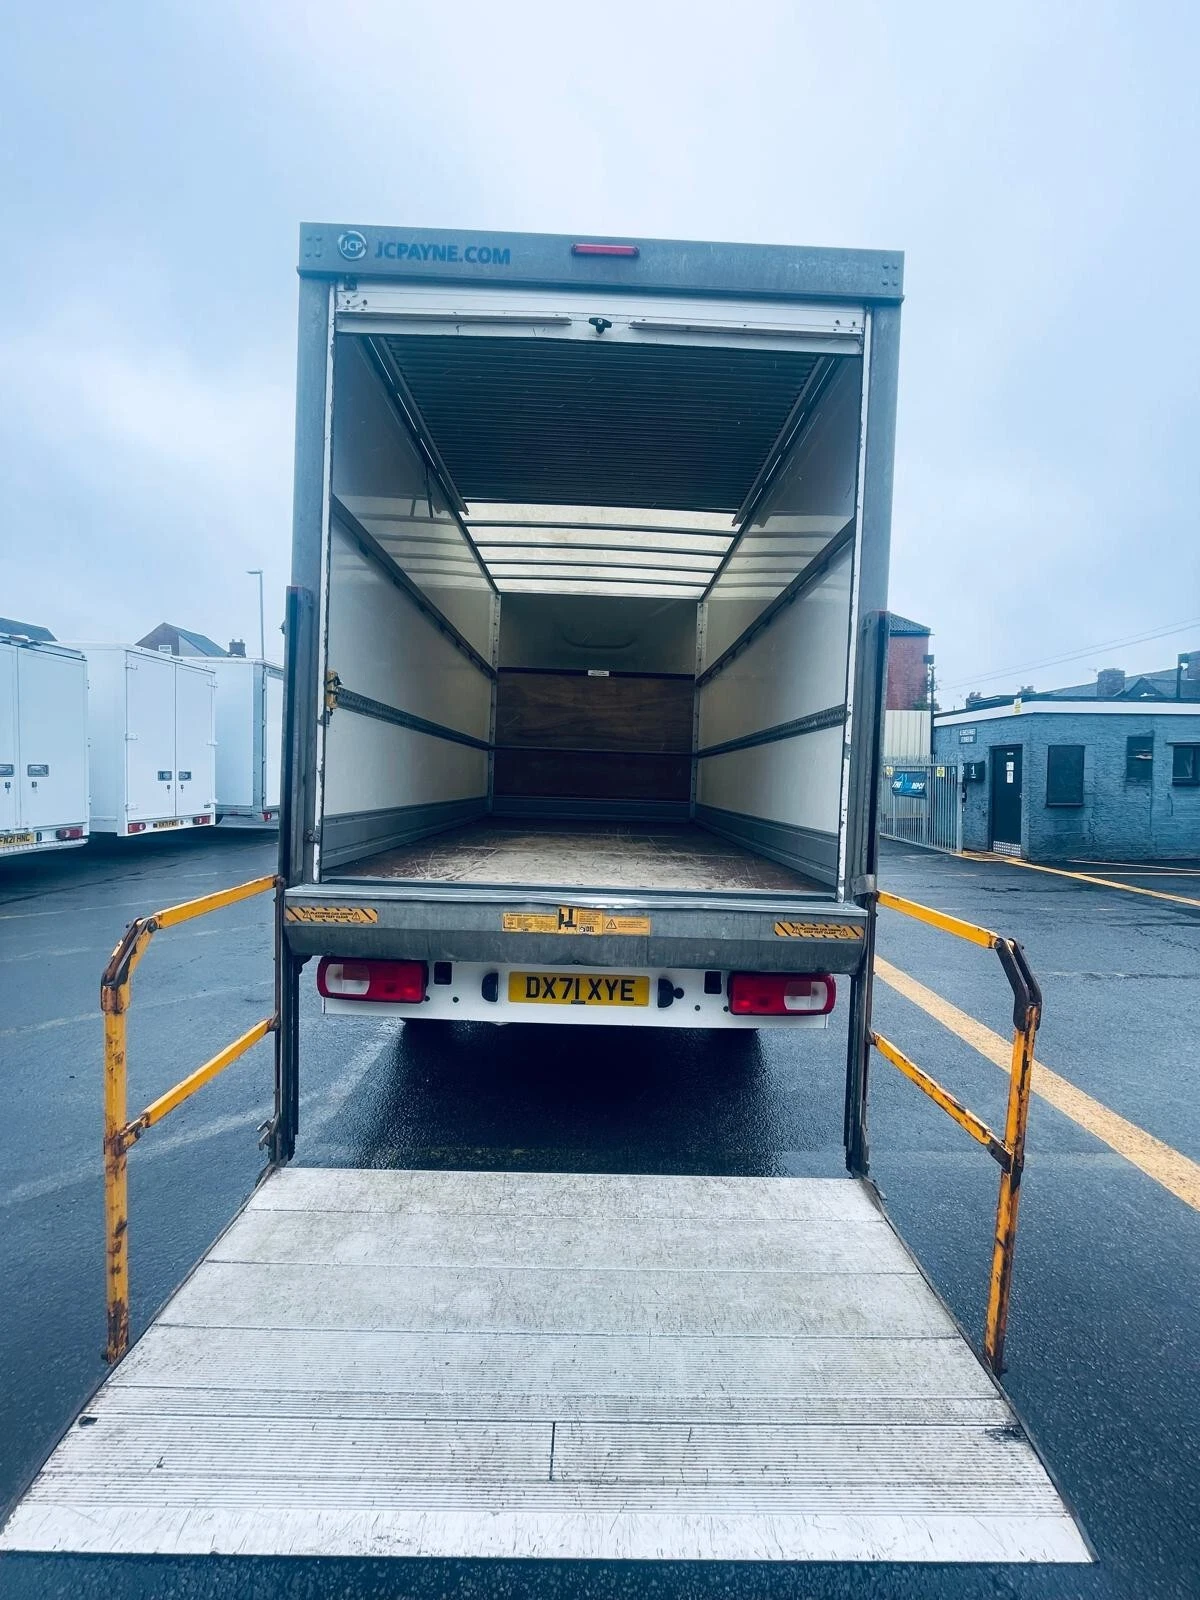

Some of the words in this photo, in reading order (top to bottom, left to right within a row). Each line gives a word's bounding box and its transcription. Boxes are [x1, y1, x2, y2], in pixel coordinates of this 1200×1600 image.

[342, 240, 363, 252] JCP
[375, 241, 511, 265] JCPAYNE.COM
[525, 976, 580, 1000] DX71
[587, 978, 636, 1001] XYE
